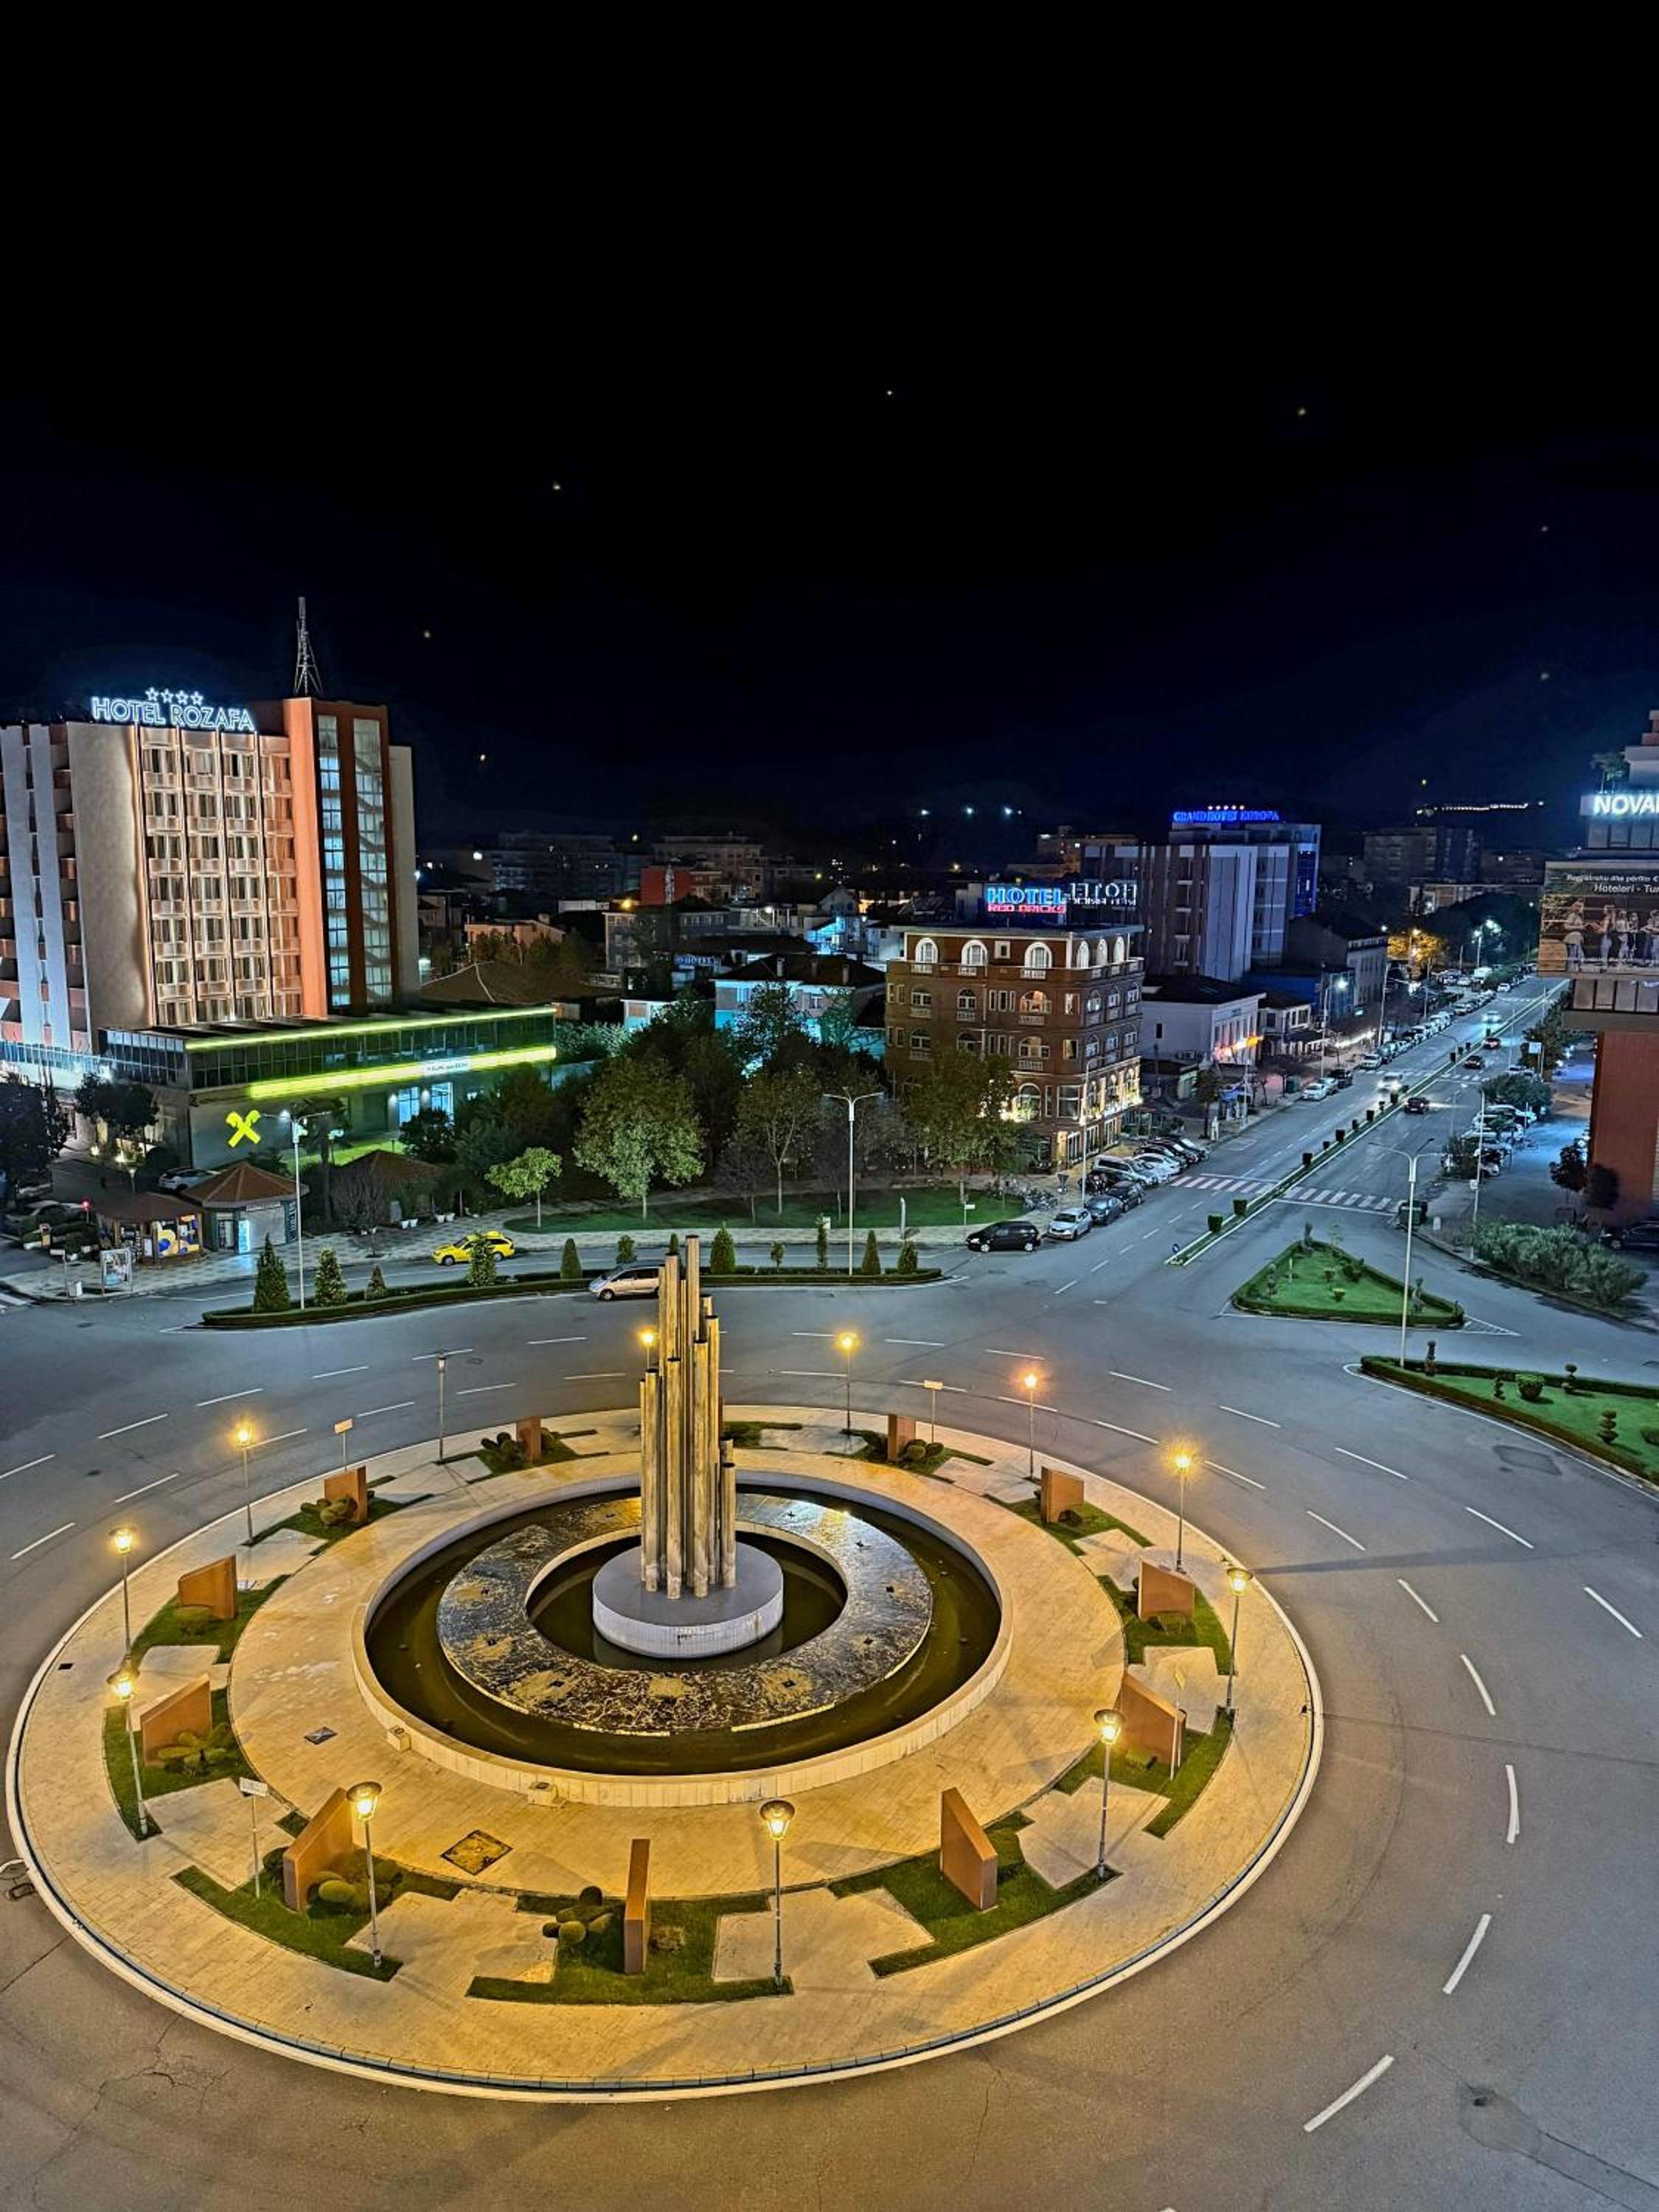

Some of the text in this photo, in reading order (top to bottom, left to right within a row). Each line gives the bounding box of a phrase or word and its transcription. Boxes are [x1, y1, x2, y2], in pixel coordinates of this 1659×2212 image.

[91, 697, 256, 731] HOTEL ROZAFA
[1593, 796, 1659, 815] NOVA
[987, 887, 1068, 904] HOTEL
[987, 904, 1015, 913] RED
